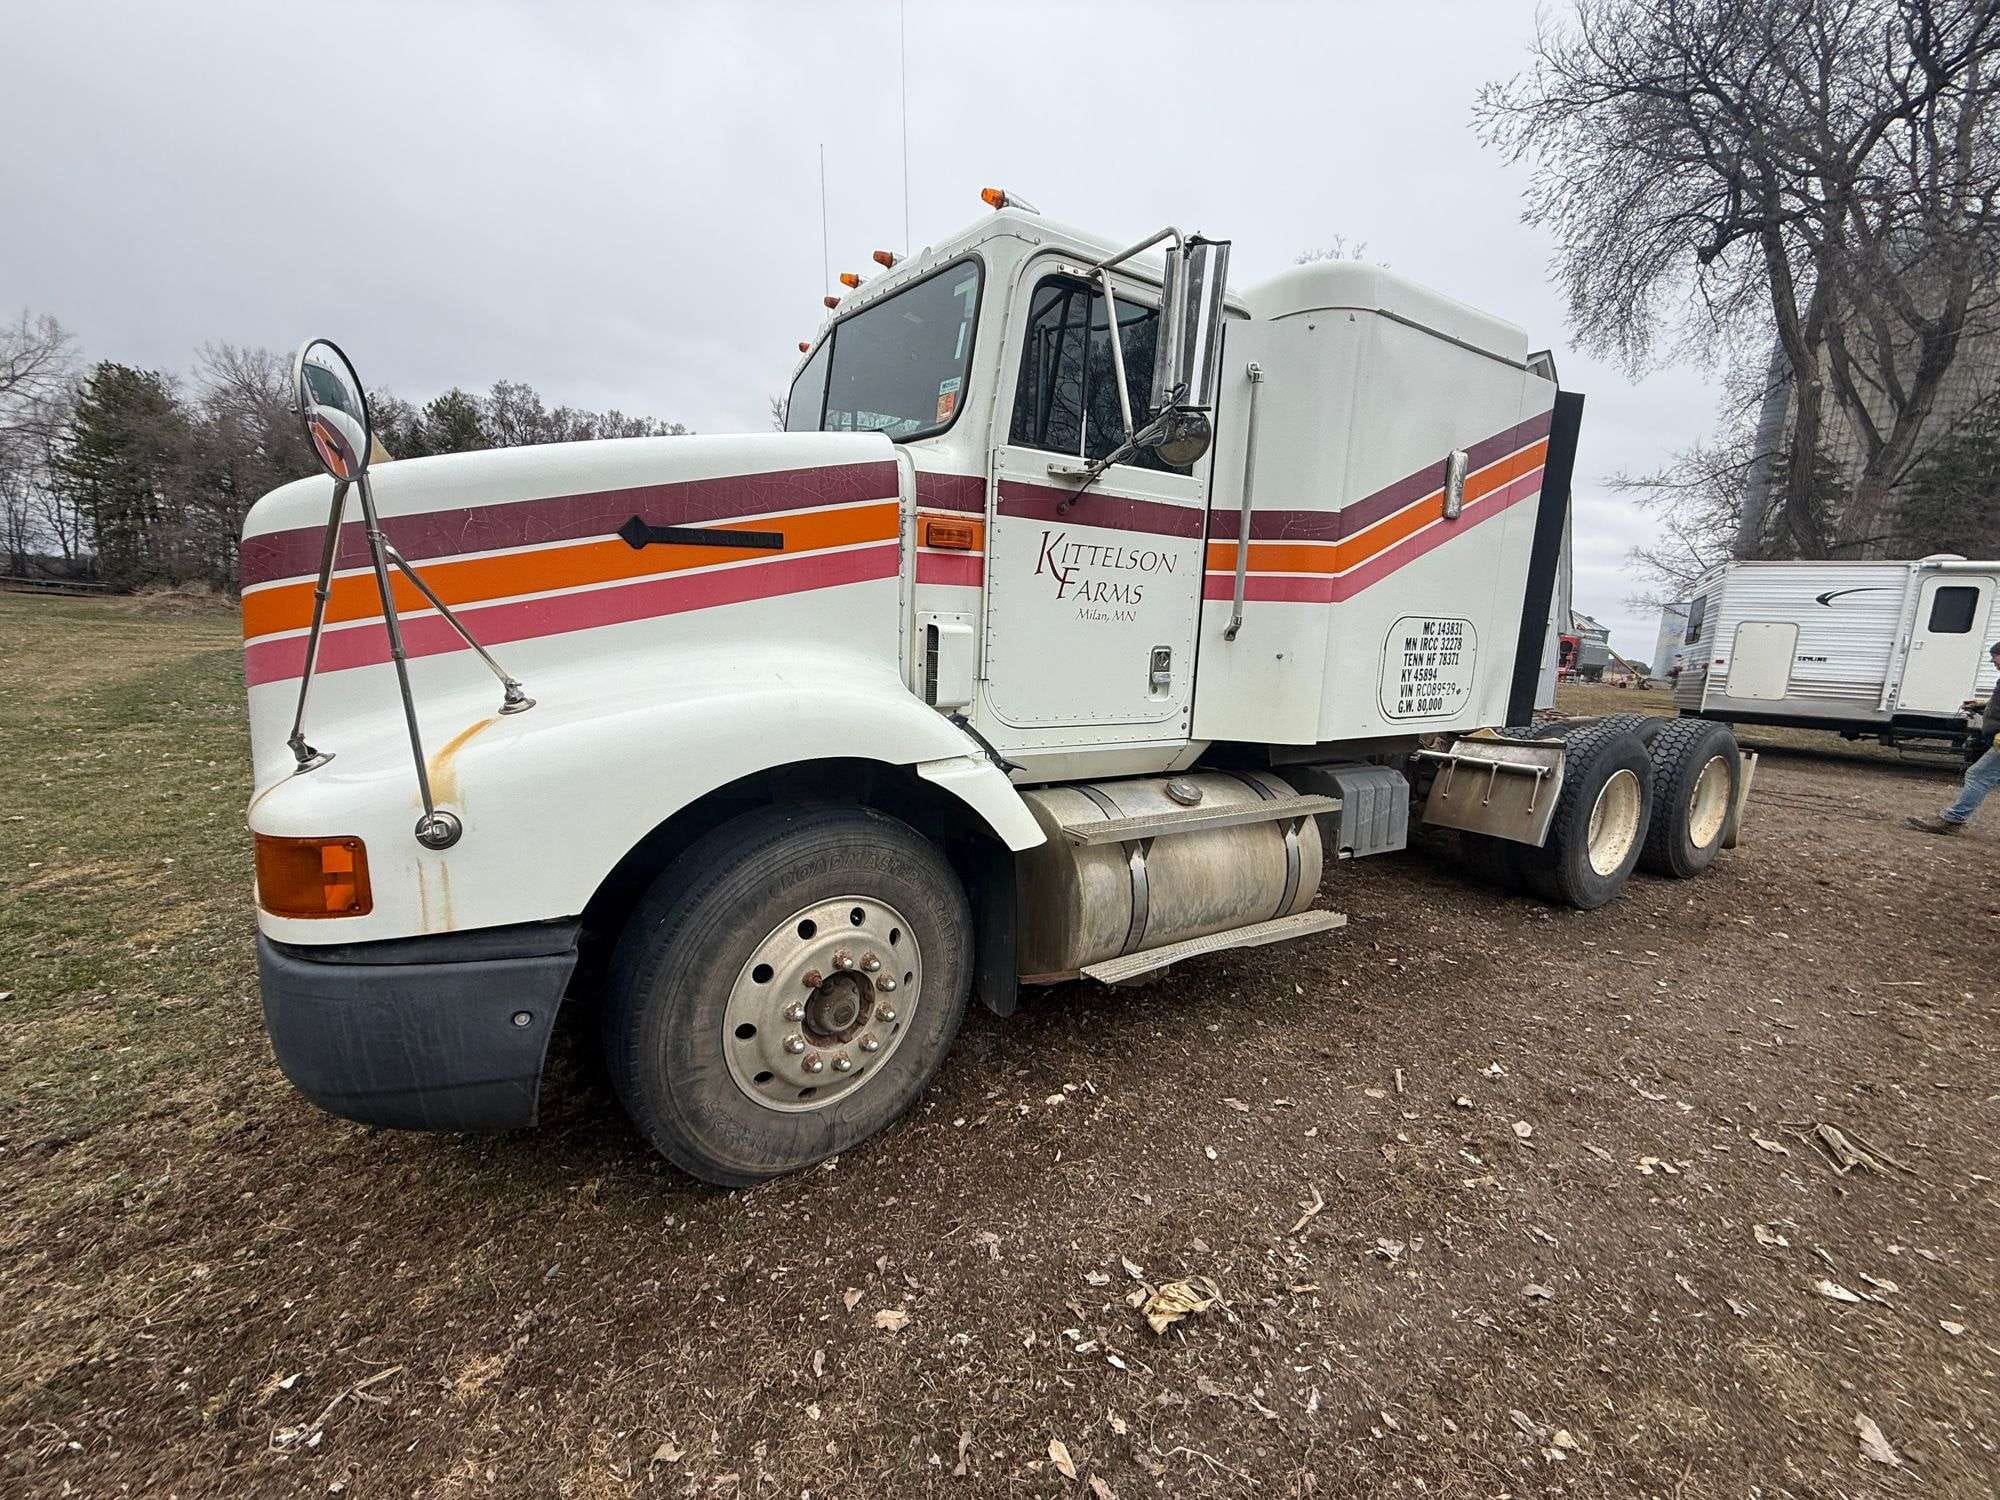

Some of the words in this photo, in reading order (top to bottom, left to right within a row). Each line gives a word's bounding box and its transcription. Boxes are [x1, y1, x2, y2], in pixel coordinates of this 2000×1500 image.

[1034, 531, 1178, 582] KITTELSON
[1056, 567, 1144, 605] FARMS
[1075, 608, 1110, 623] Milan,
[1112, 610, 1137, 622] MN
[1423, 622, 1435, 635] MC
[1437, 622, 1463, 635] 143831
[1404, 638, 1417, 650] MN
[1420, 638, 1438, 650] IRCC
[1440, 637, 1462, 650] 32278
[1404, 653, 1424, 666] TENN
[1426, 653, 1437, 666] HF
[1439, 653, 1459, 665] 78371
[1401, 669, 1412, 682] KY
[1414, 668, 1437, 681] 45894
[1400, 684, 1414, 697] VIN
[1398, 699, 1414, 713] G.W.
[1417, 697, 1442, 714] 80,000
